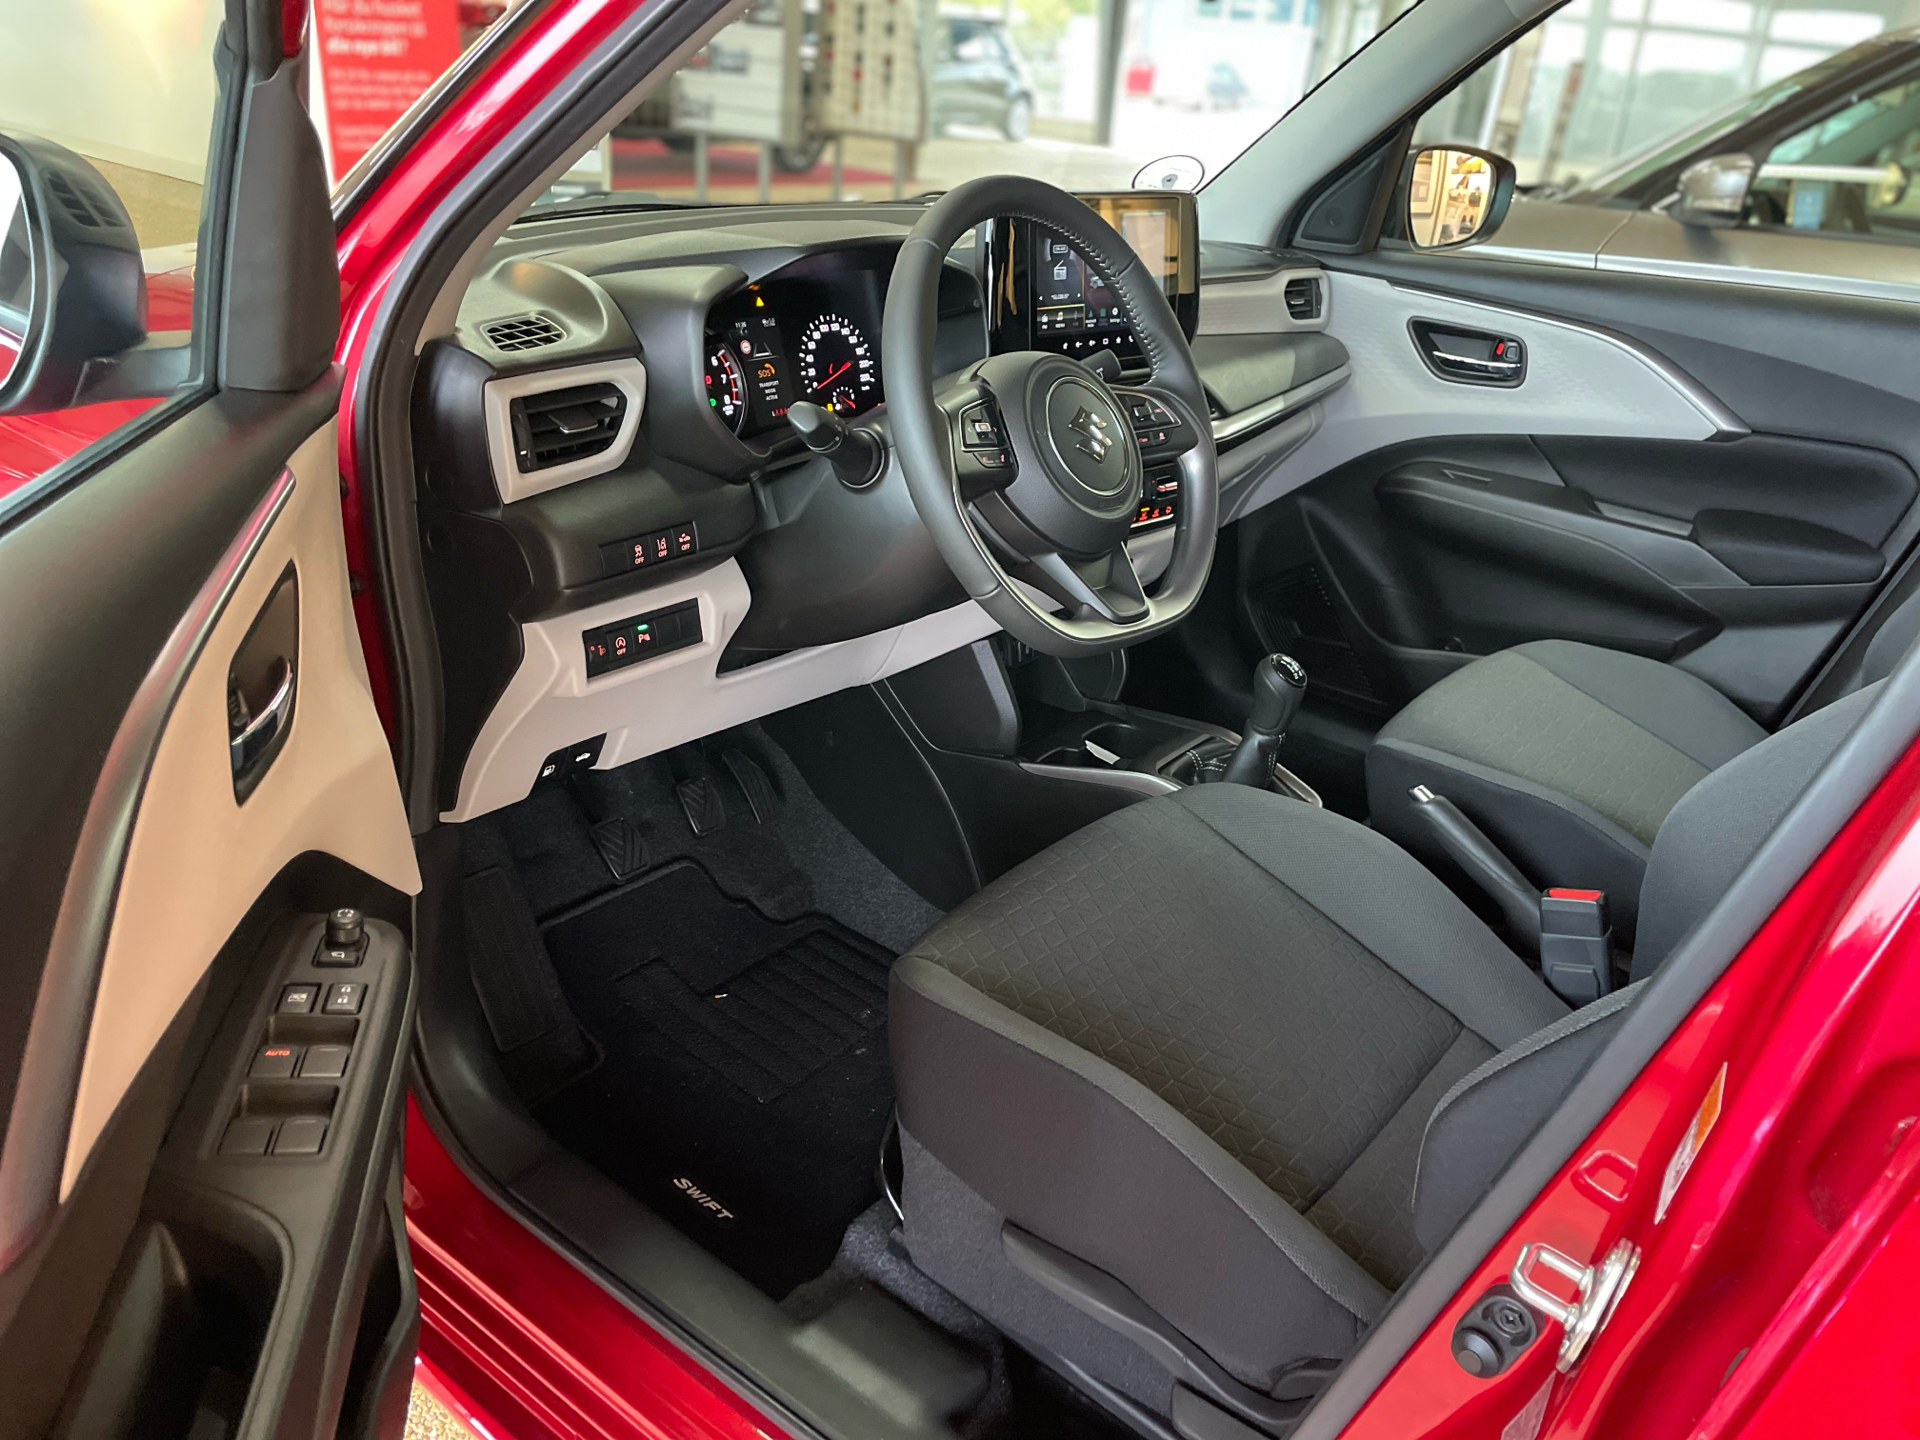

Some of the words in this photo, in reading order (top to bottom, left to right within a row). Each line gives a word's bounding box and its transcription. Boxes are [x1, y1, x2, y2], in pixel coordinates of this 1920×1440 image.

[711, 356, 718, 366] 6
[757, 369, 771, 378] SOS
[720, 374, 726, 384] 7
[681, 543, 691, 551] OFF
[658, 549, 668, 557] OFF
[634, 556, 645, 564] OFF
[616, 647, 626, 655] OFF
[673, 1178, 734, 1218] SWIFT
